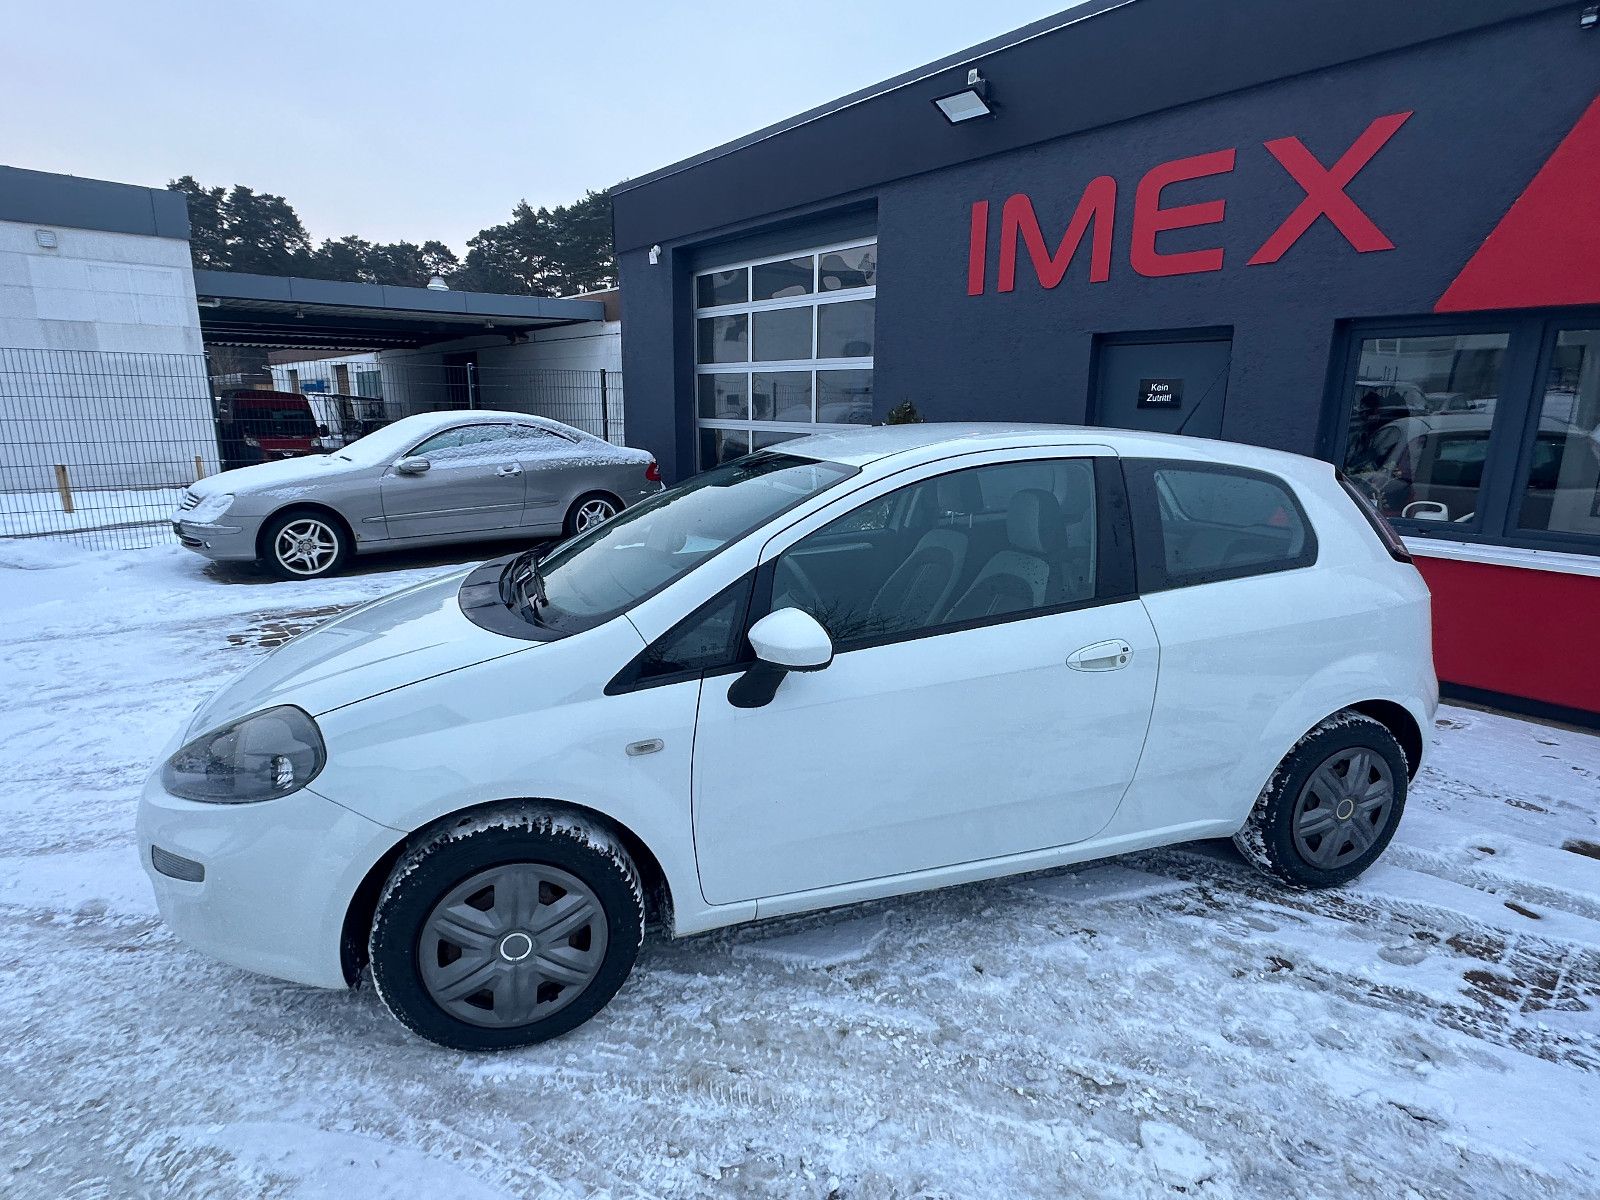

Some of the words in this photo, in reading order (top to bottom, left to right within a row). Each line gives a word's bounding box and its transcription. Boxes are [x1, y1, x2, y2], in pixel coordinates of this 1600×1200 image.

[967, 110, 1415, 296] IMEX
[1150, 383, 1169, 392] Kein
[1146, 393, 1172, 402] Zutritt!
